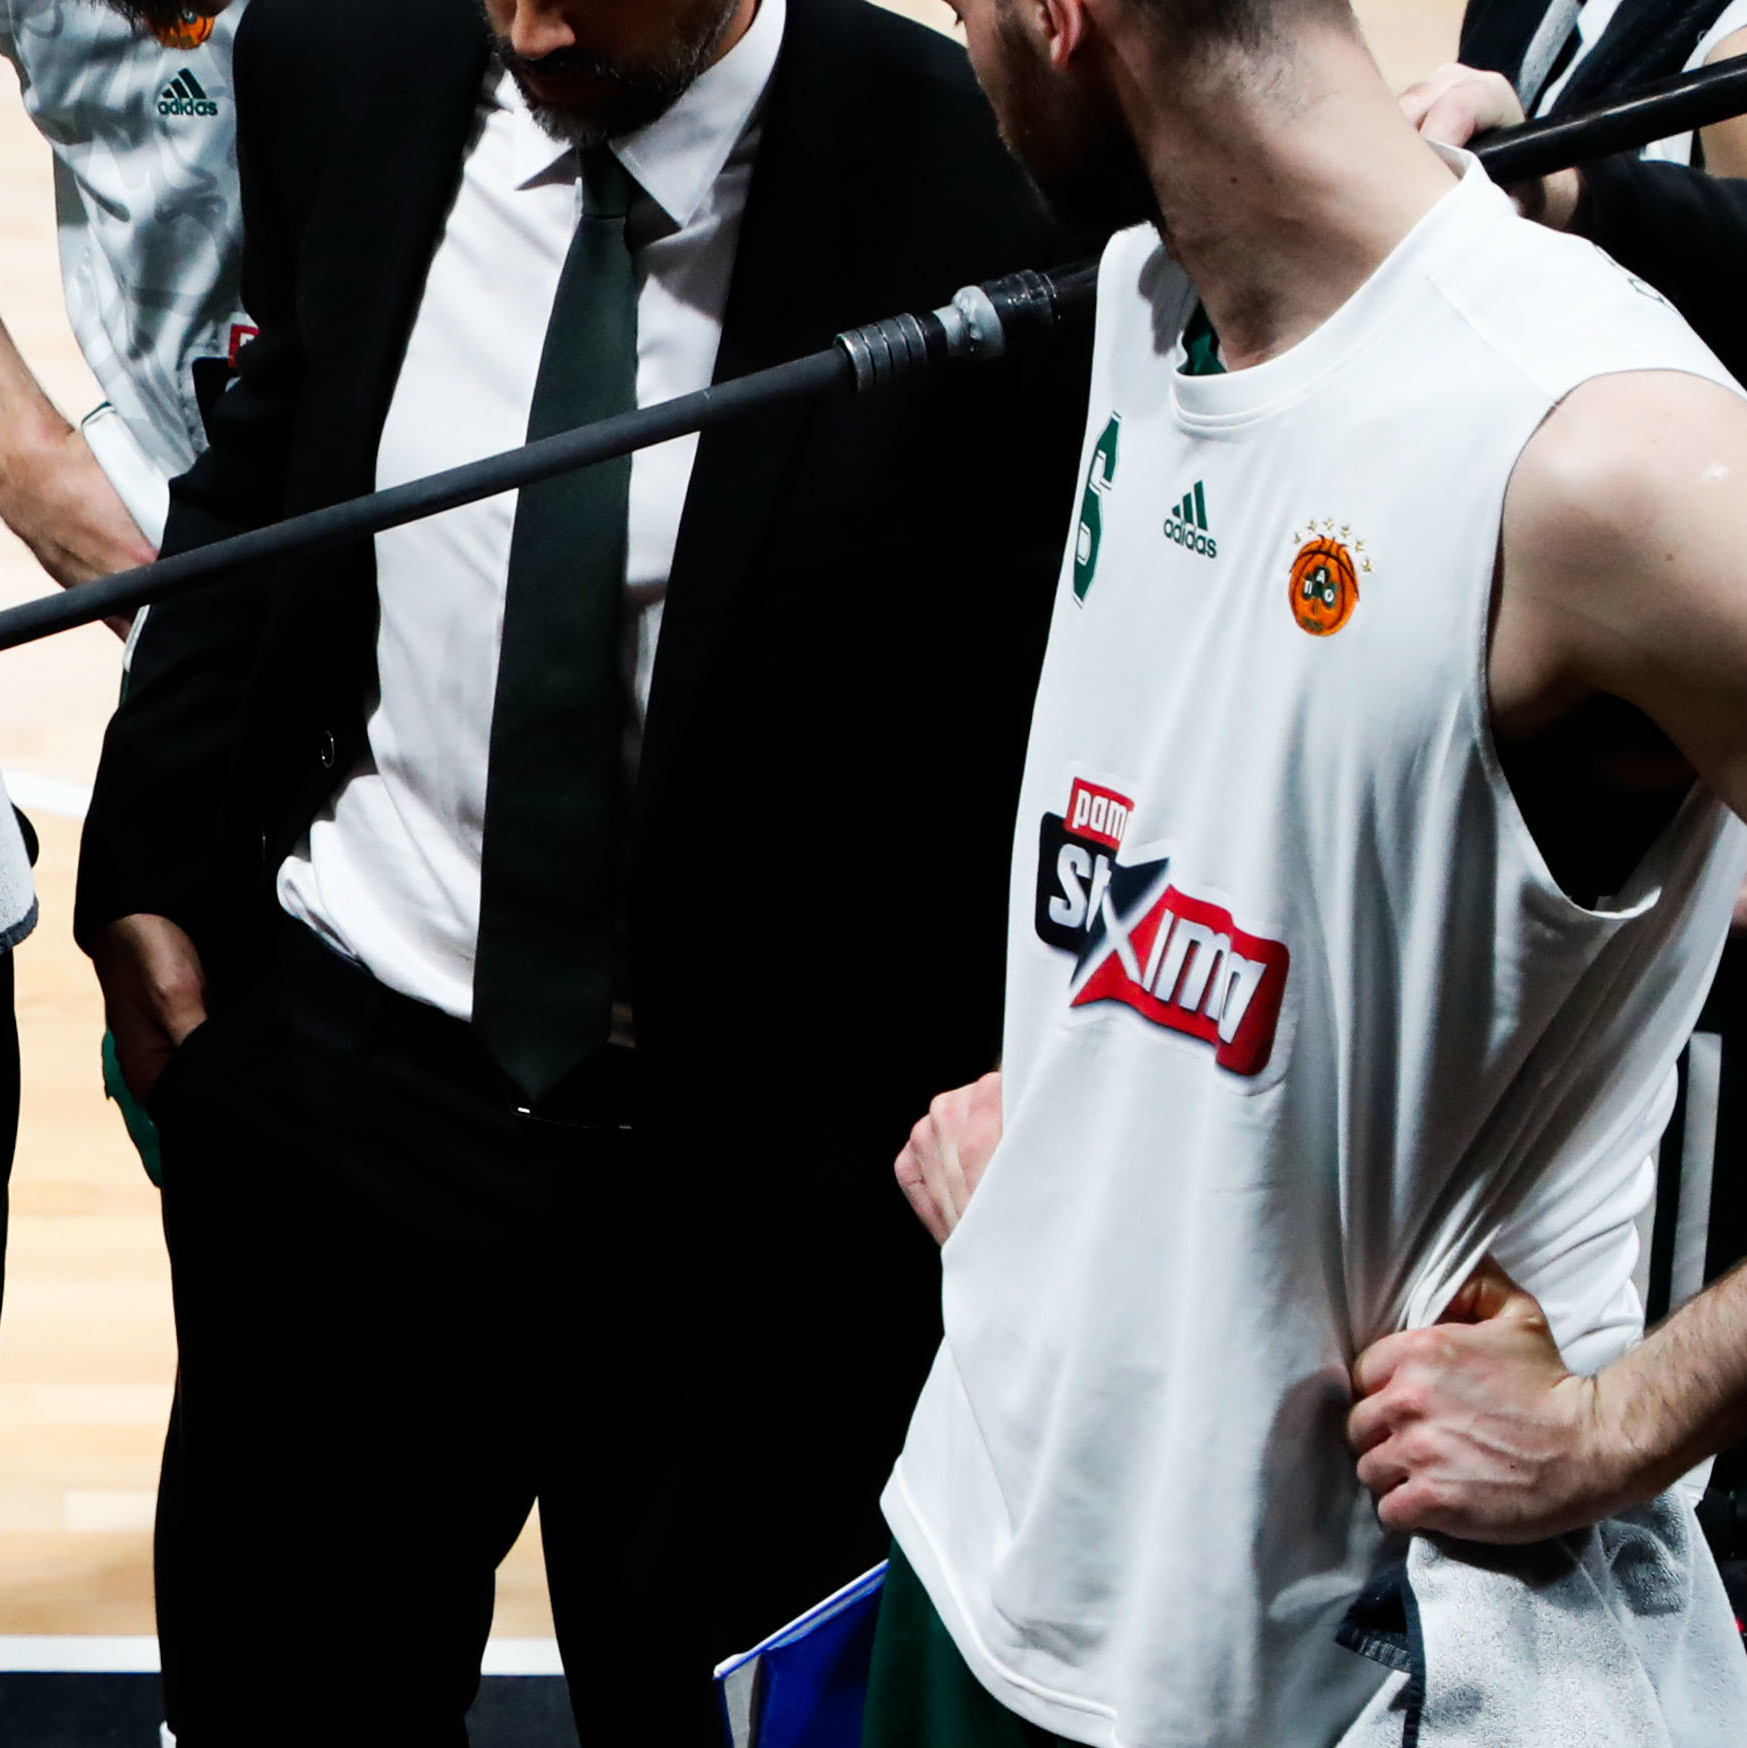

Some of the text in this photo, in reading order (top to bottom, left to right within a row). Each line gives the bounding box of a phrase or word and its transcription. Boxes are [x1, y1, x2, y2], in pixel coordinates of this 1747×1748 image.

[157, 97, 218, 116] adidas
[1163, 517, 1217, 558] adidas
[1071, 788, 1127, 842] pam
